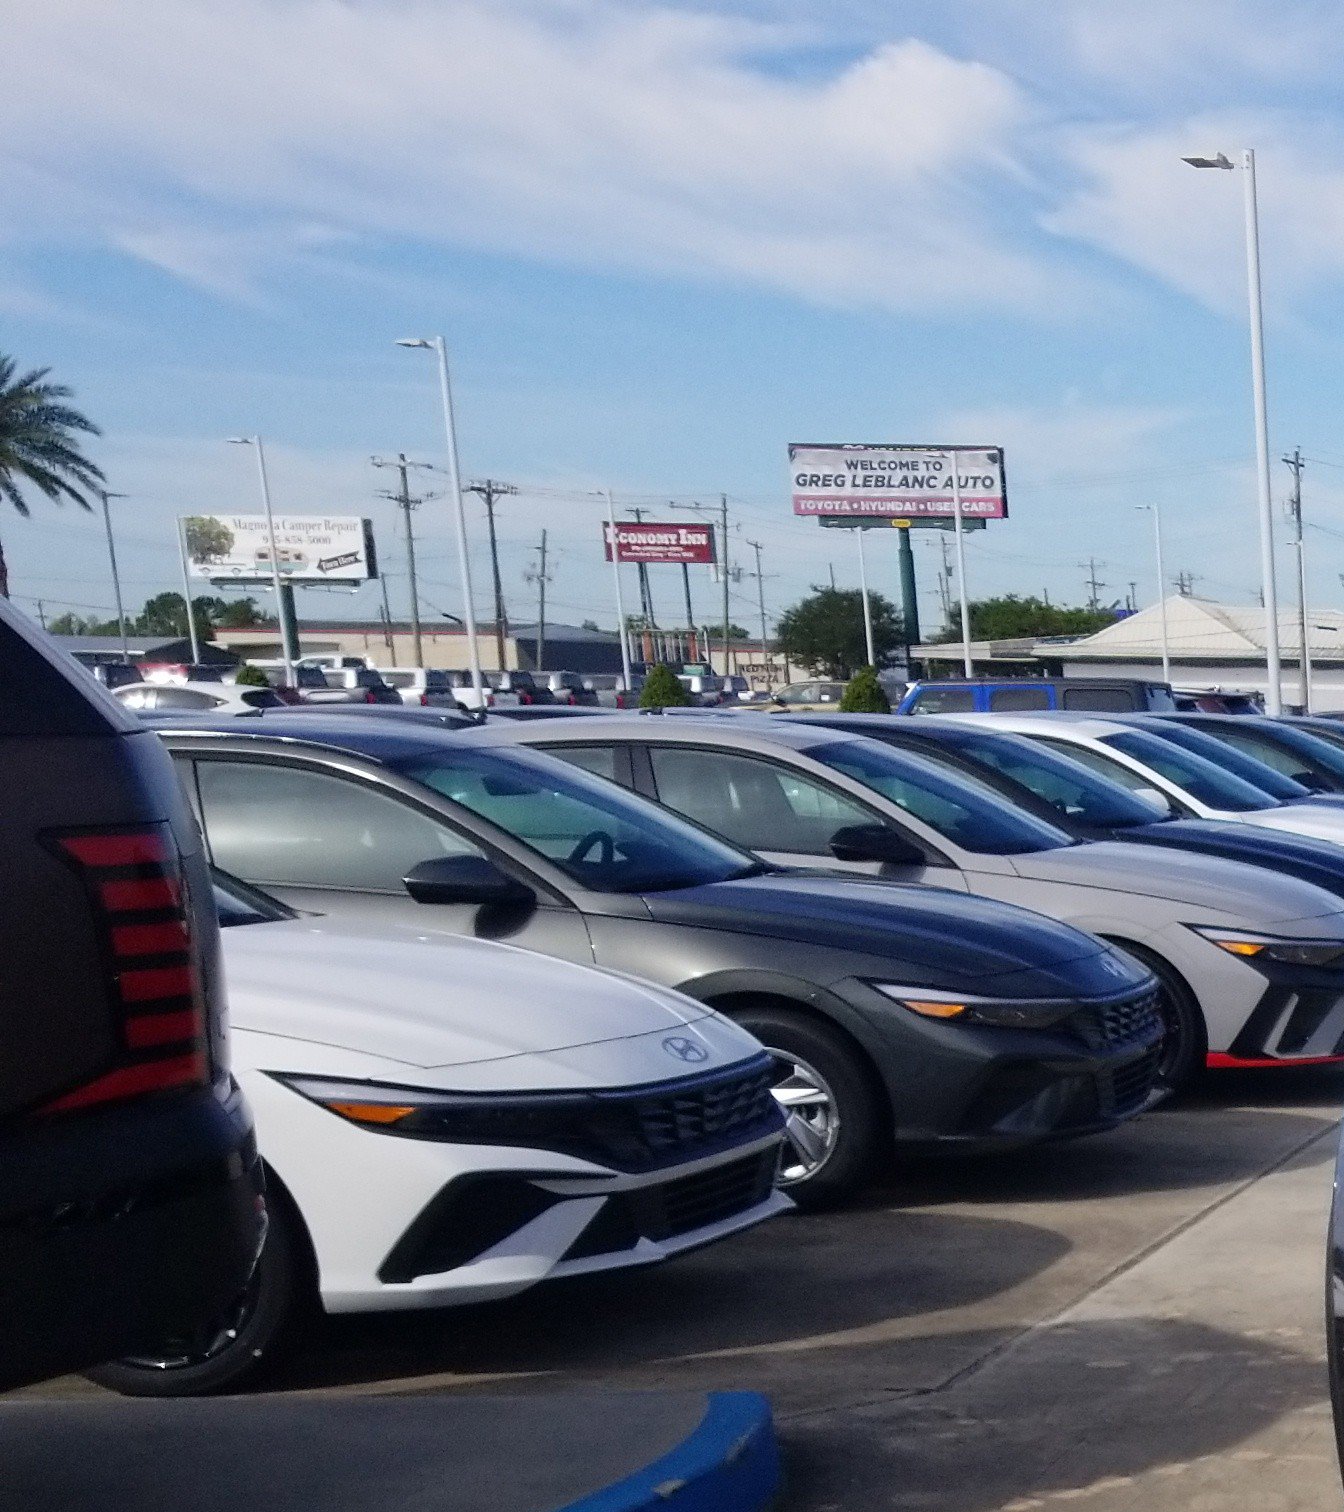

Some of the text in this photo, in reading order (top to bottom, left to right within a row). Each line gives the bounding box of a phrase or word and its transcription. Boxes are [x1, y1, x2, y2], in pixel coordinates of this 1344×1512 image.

[845, 459, 943, 472] WELCOME TO
[795, 473, 994, 489] GREG LEBLANC AUTO
[800, 500, 850, 510] TOYOTA
[860, 501, 917, 511] HYUNDAI
[962, 502, 995, 512] CARS
